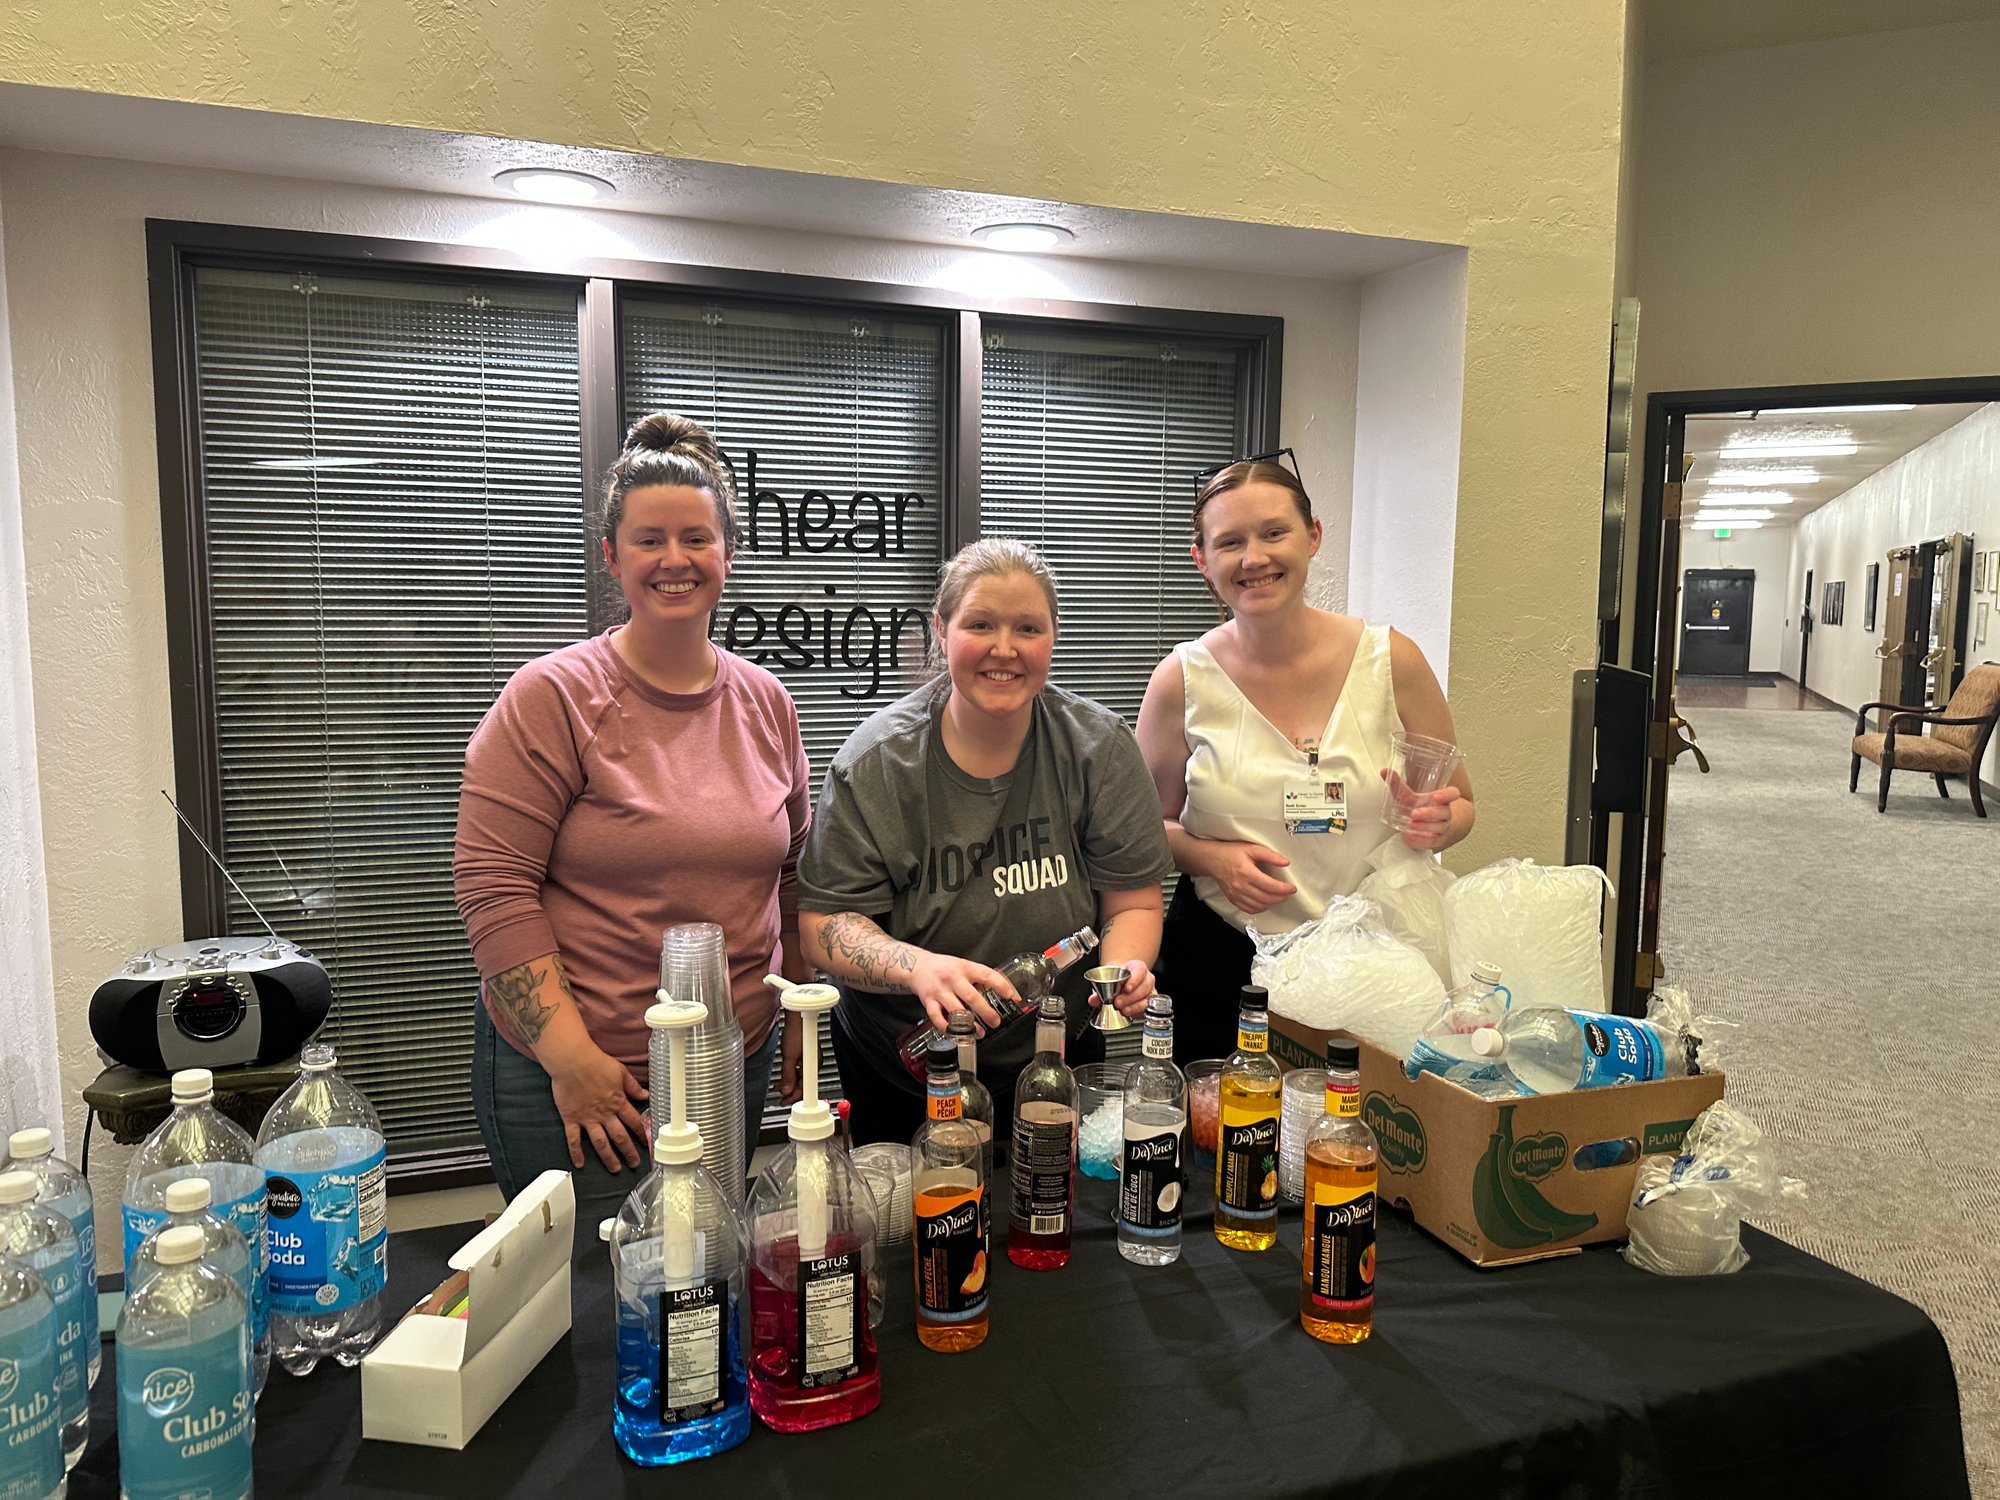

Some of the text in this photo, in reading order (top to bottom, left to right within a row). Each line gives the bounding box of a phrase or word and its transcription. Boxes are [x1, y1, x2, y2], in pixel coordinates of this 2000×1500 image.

[709, 584, 934, 700] esign
[992, 854, 1068, 898] SQUAD
[1240, 1032, 1266, 1042] PINEAPPLE
[1243, 1041, 1263, 1050] ANANAS
[1613, 1027, 1628, 1061] Club
[1621, 1027, 1638, 1065] Soda
[936, 1098, 957, 1109] PEACH
[1232, 1124, 1276, 1147] DaVinci
[1367, 1107, 1422, 1154] Del Monte
[1648, 1131, 1685, 1147] PLANT
[1131, 1139, 1175, 1161] DaVinci
[1515, 1145, 1565, 1164] Del Monte
[1130, 1173, 1139, 1192] COCO
[926, 1206, 975, 1239] DaVinci
[1326, 1198, 1374, 1228] DaVinci
[810, 1254, 849, 1272] LOTUS
[1320, 1233, 1331, 1295] MANGO/MANGUE
[807, 1274, 853, 1289] Nutrition Facts
[674, 1285, 714, 1303] LOTUS
[669, 1306, 719, 1321] Nutrition Facts
[57, 1320, 82, 1348] da
[59, 1350, 74, 1364] INK
[163, 1405, 226, 1443] Club
